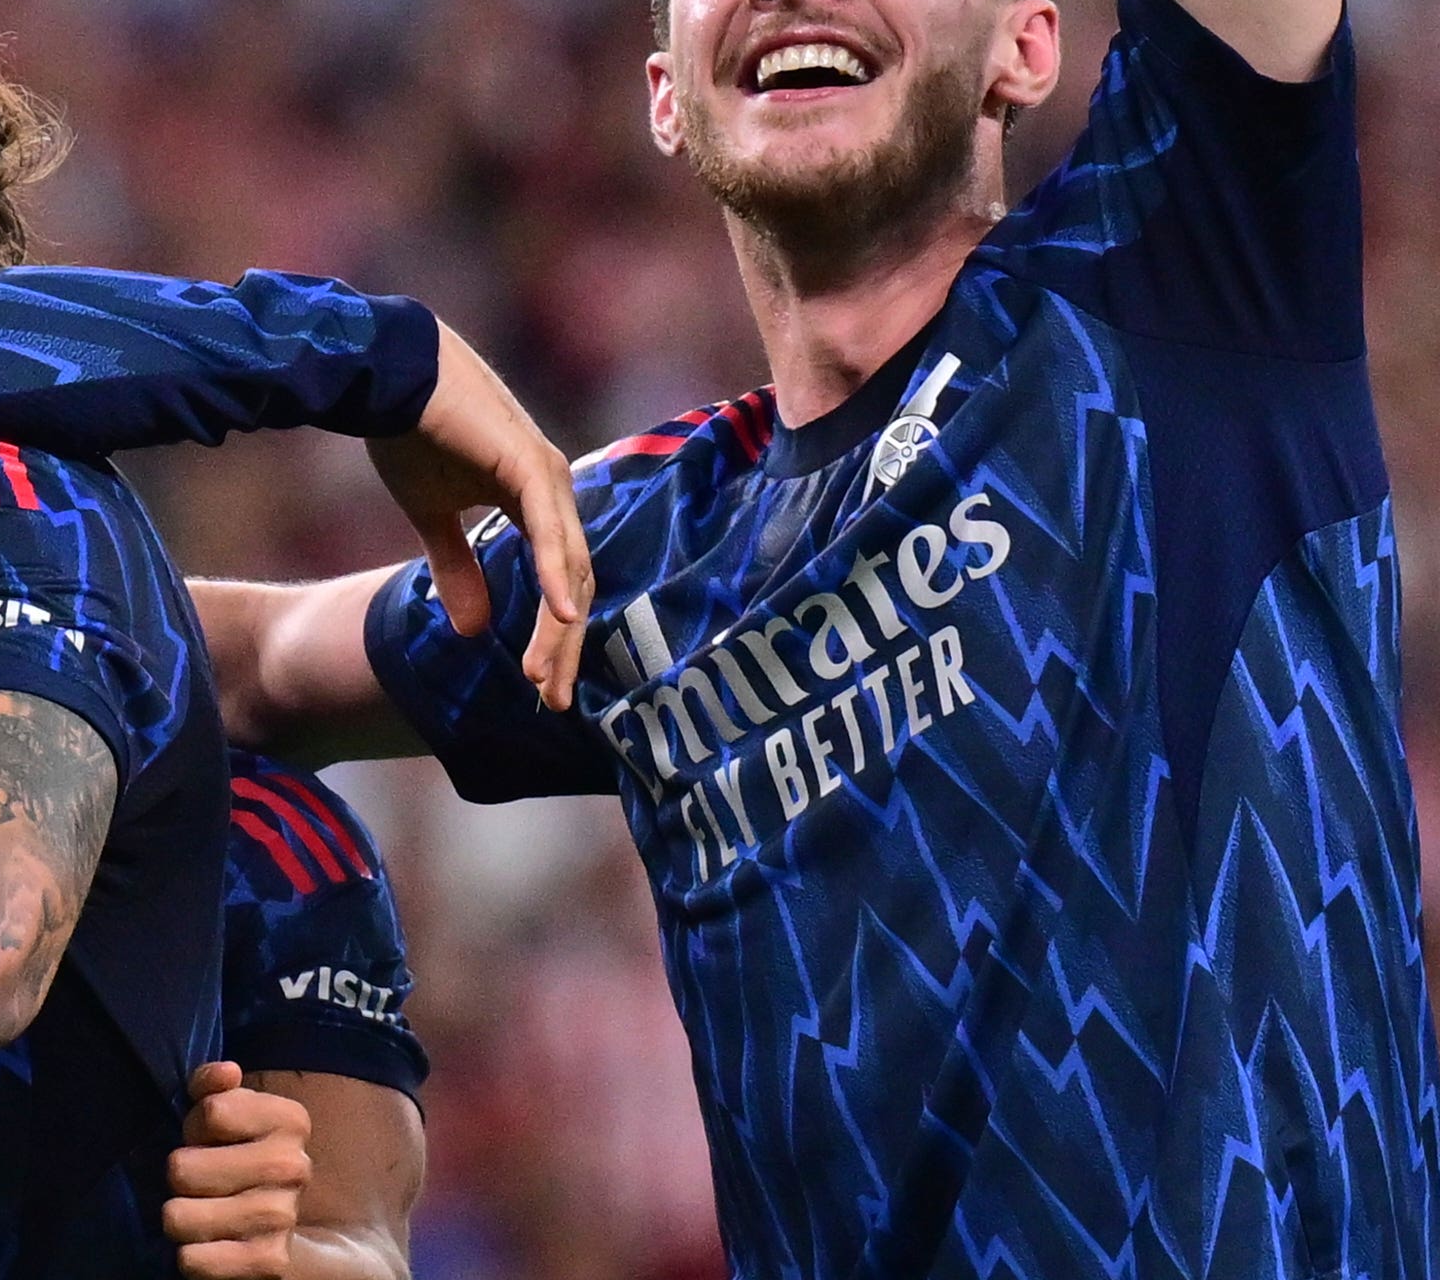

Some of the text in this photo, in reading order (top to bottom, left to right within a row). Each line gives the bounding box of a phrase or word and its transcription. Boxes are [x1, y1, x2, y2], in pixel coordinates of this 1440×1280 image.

[600, 493, 1011, 806] Emirates
[681, 625, 976, 883] FLY BETTER
[278, 966, 394, 1022] VISIT
